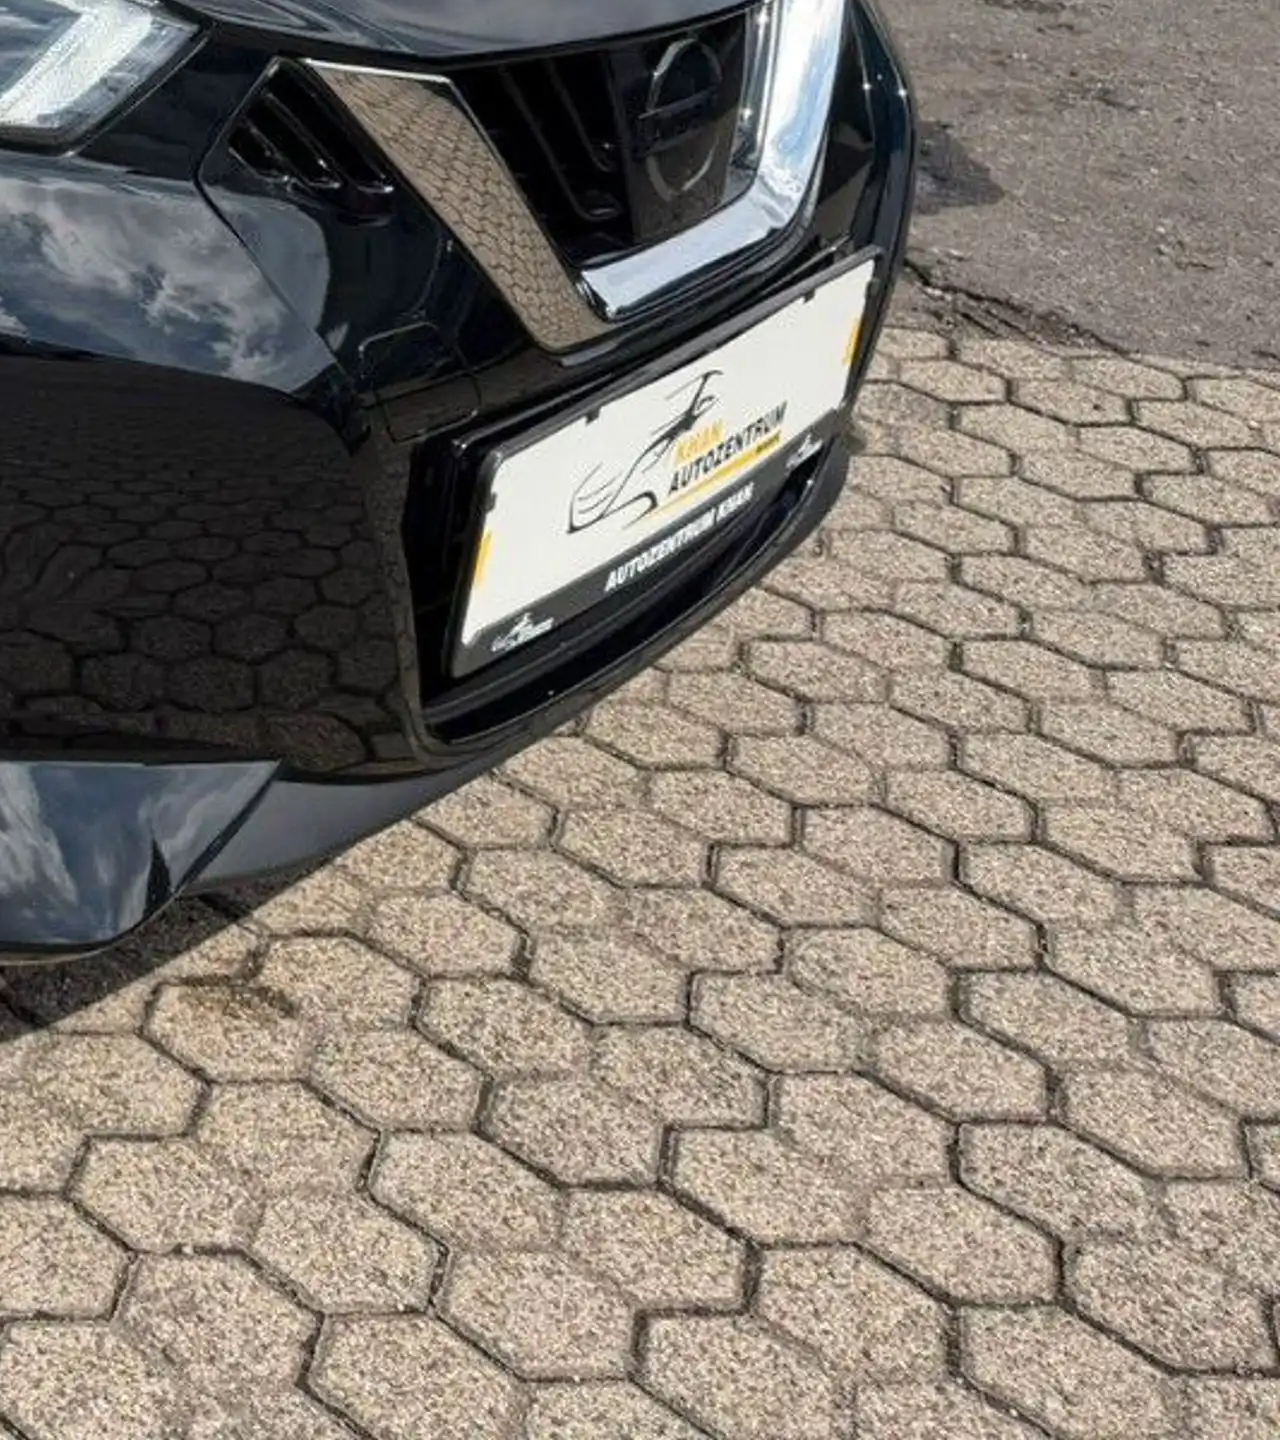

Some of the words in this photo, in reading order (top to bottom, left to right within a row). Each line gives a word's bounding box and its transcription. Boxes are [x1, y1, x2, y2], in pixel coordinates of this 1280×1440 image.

[668, 400, 788, 495] AUTOZENTRUM
[677, 419, 726, 461] KHAN
[605, 508, 716, 593] AUTOZENTRUM
